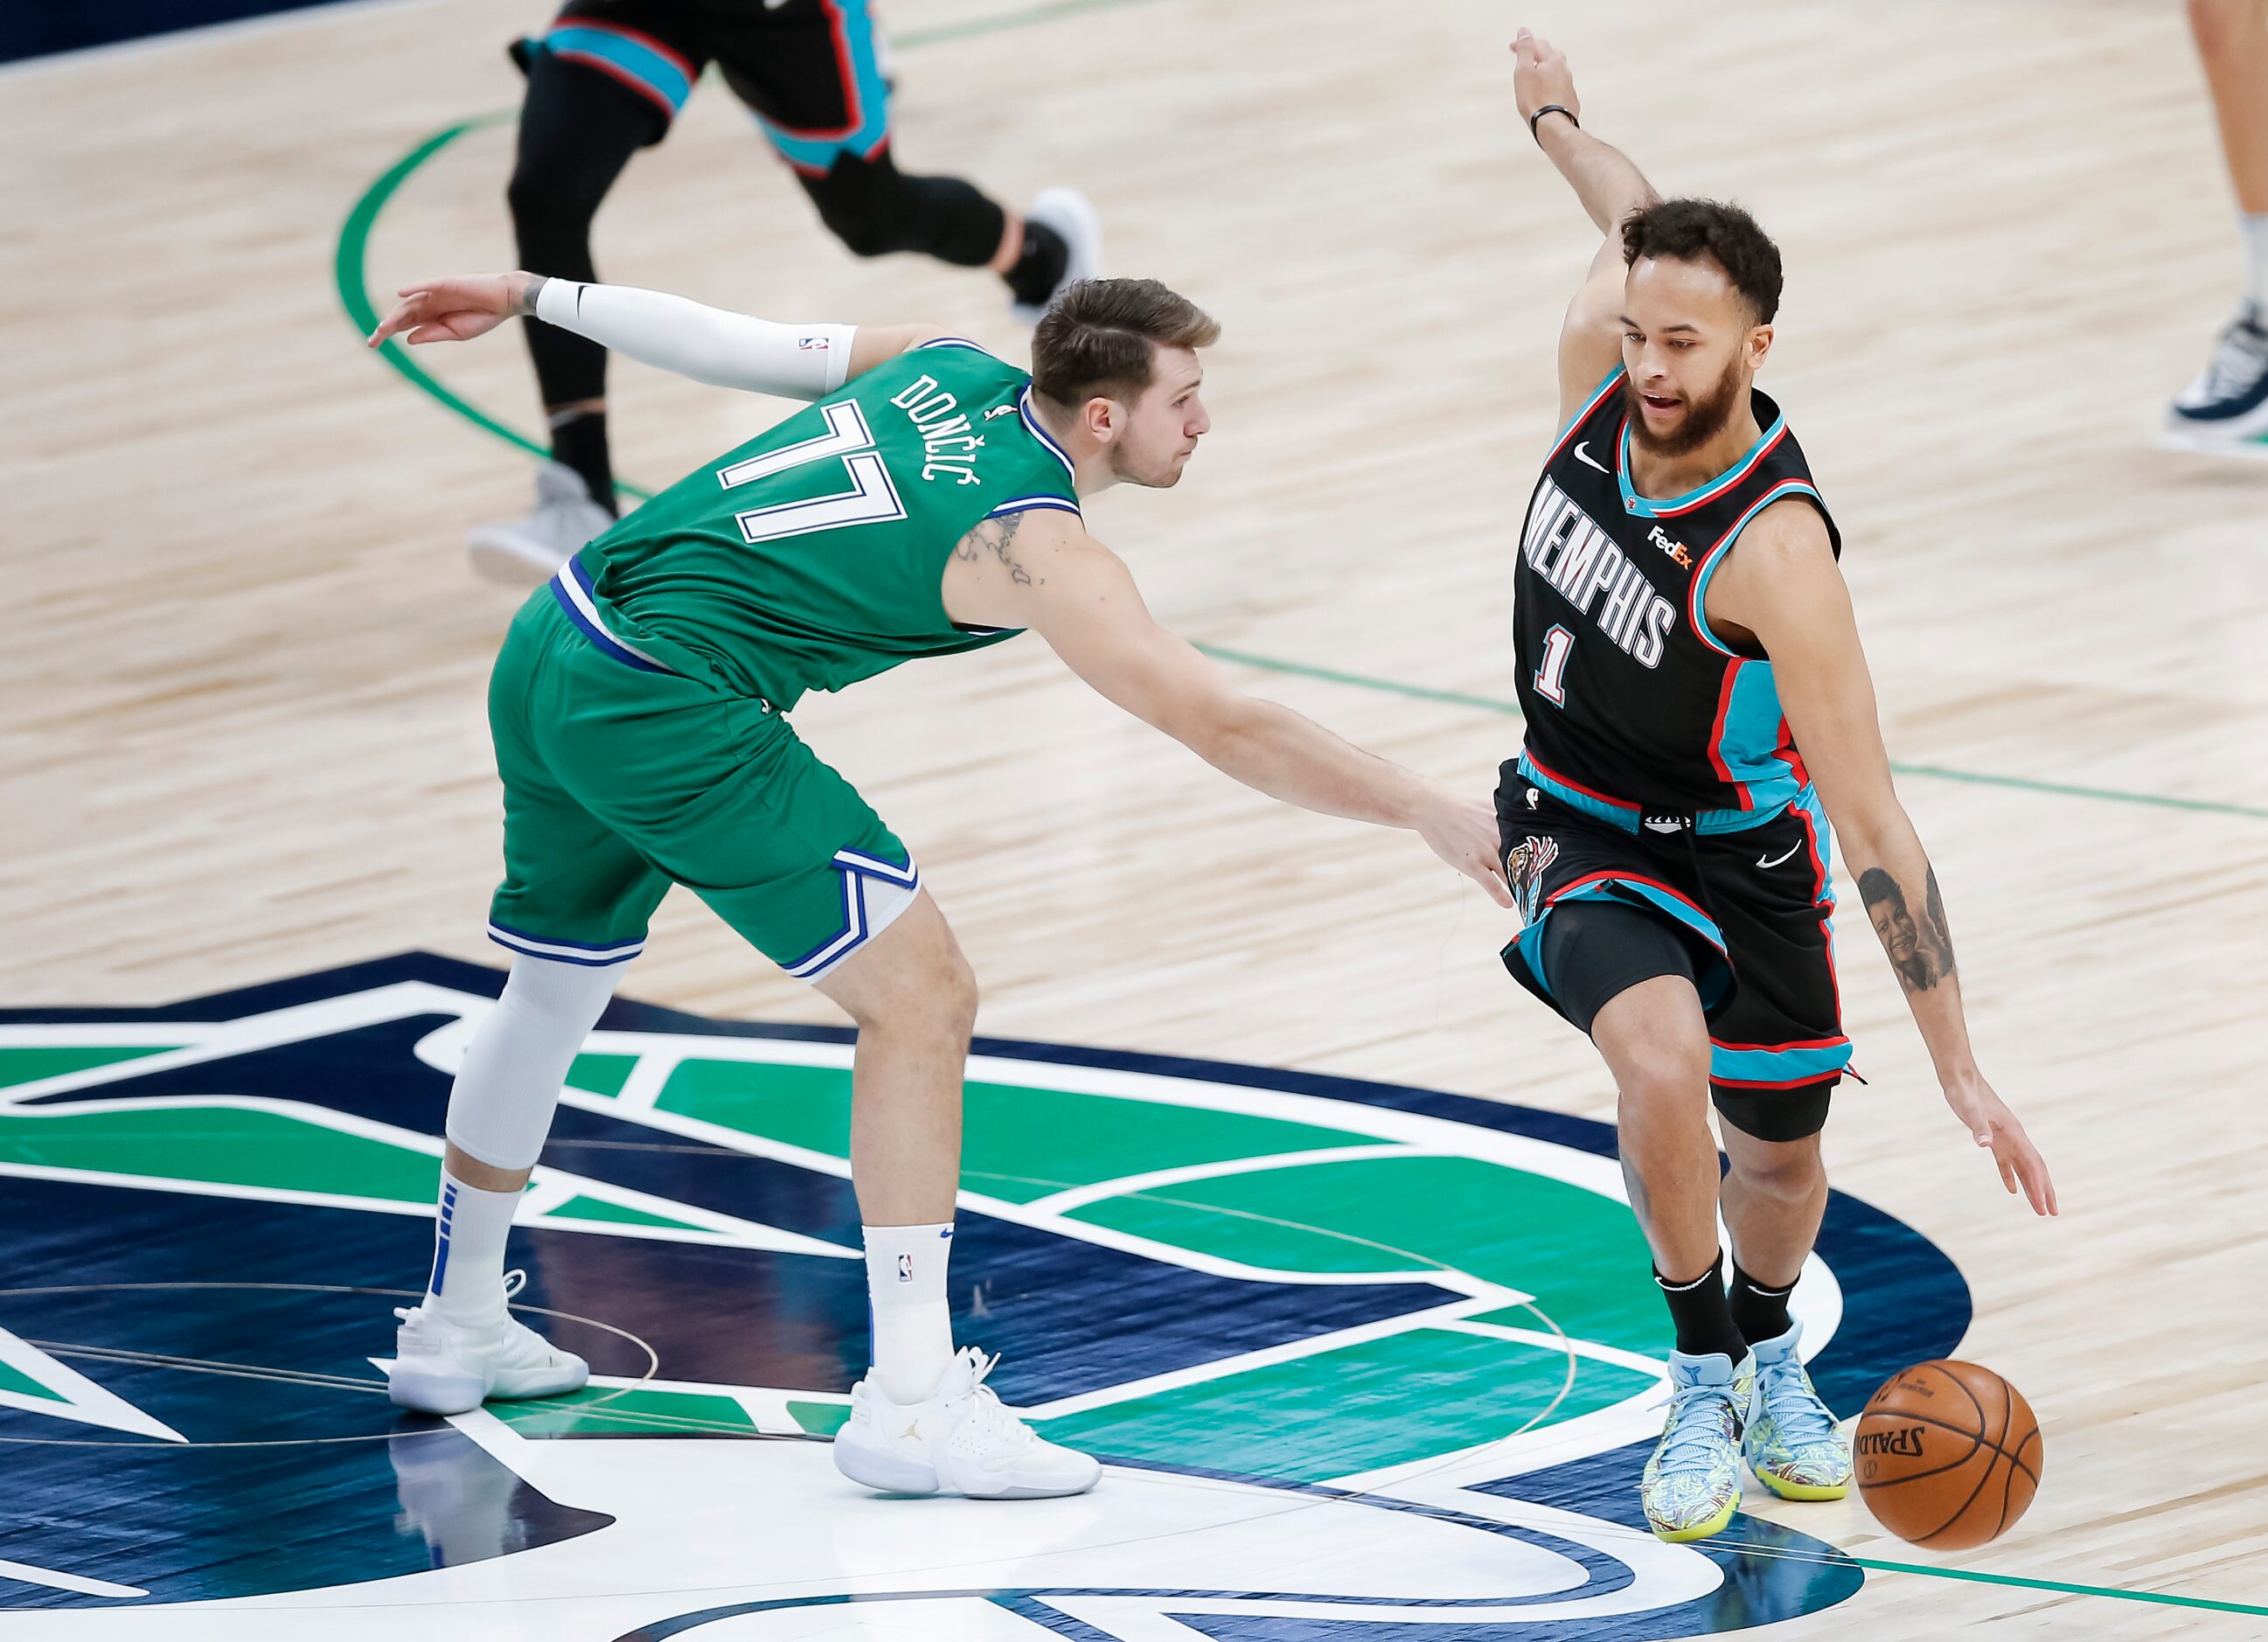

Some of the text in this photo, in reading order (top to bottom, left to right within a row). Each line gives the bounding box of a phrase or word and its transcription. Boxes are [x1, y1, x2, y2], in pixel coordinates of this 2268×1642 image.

[716, 398, 908, 544] 77
[889, 374, 985, 485] DONČIĆ
[1522, 474, 1676, 669] MEMPHIS
[1646, 525, 1694, 570] FedEx
[1534, 623, 1576, 708] 1
